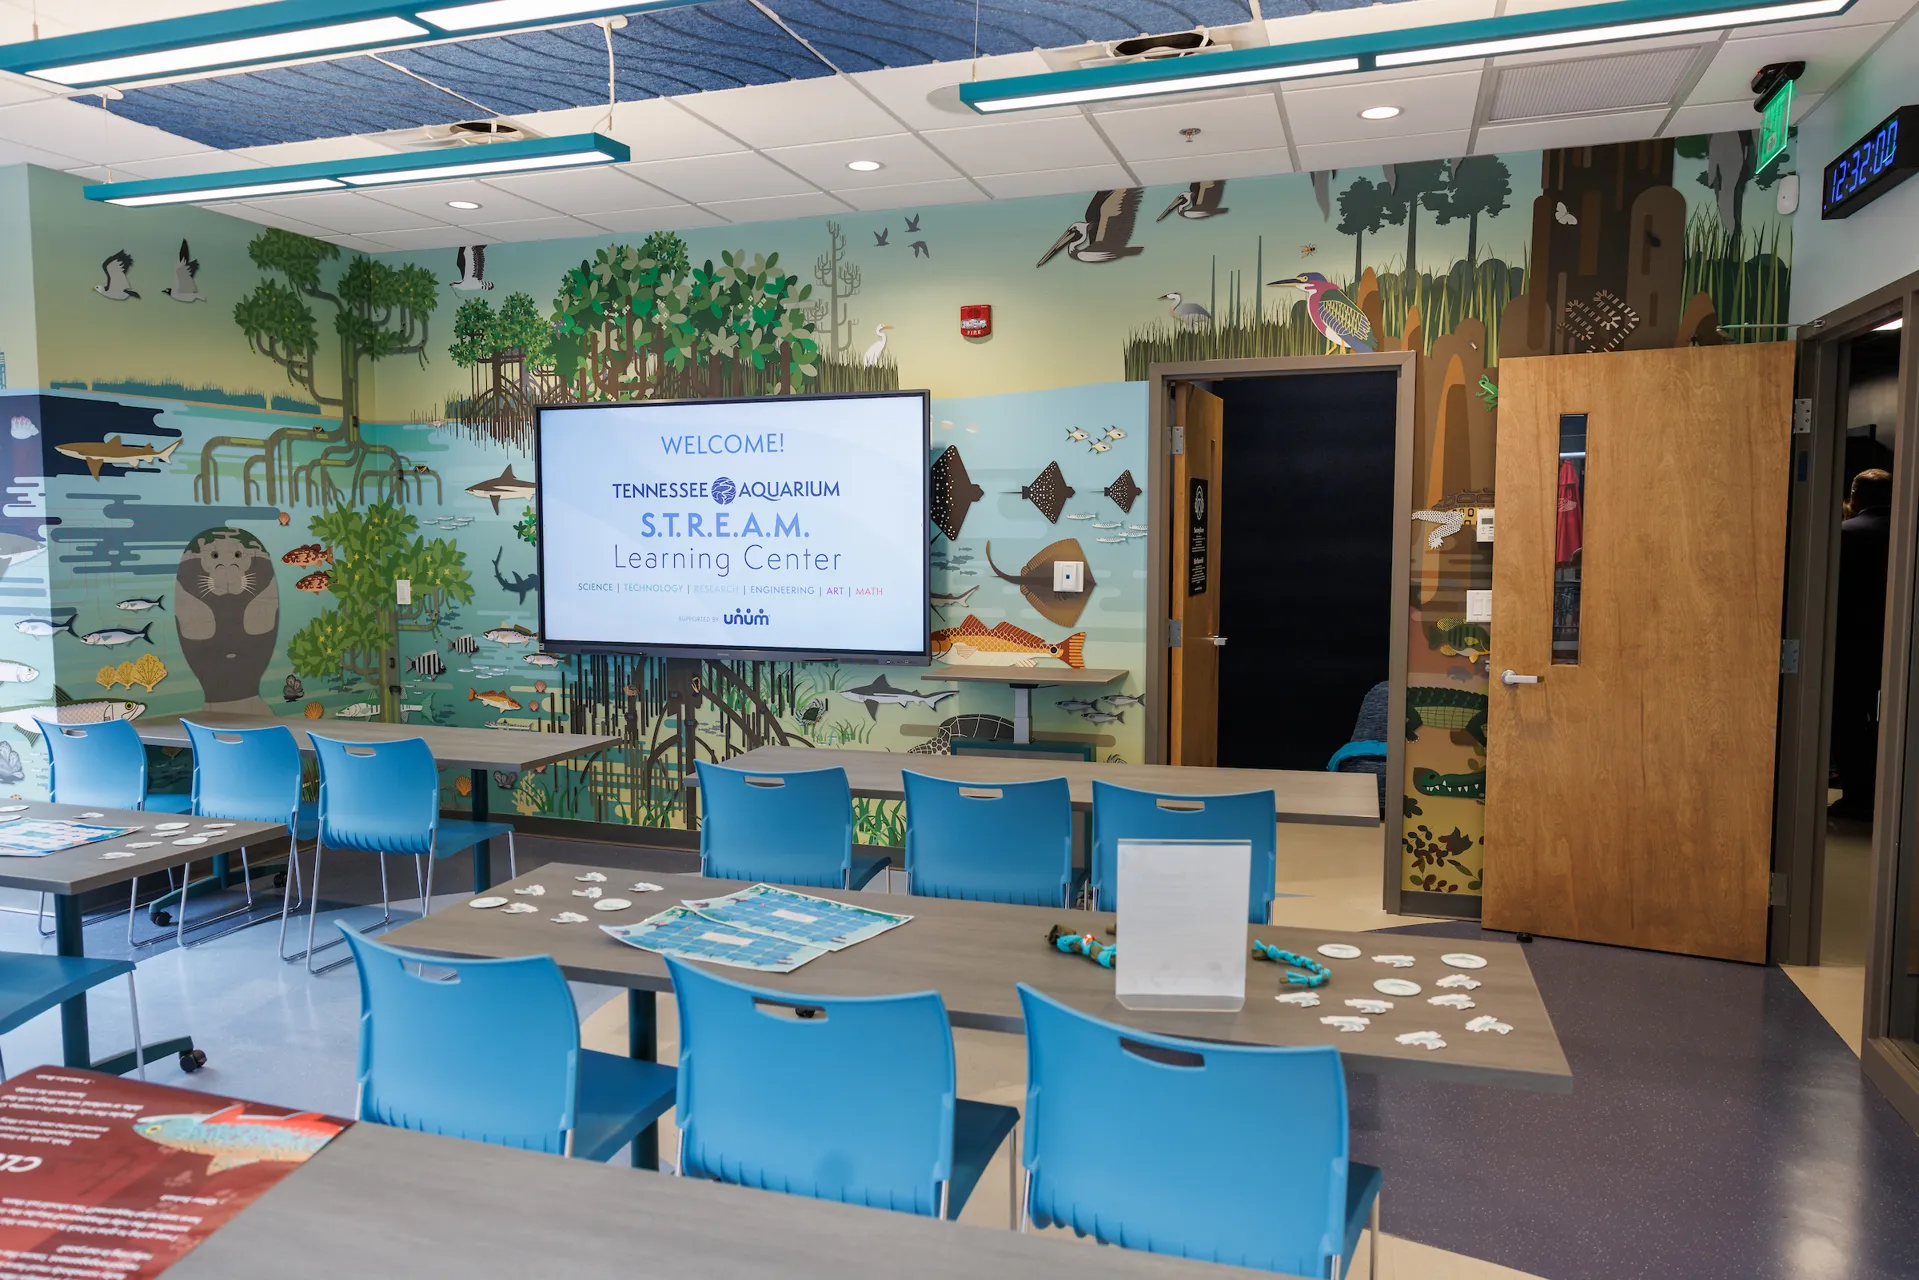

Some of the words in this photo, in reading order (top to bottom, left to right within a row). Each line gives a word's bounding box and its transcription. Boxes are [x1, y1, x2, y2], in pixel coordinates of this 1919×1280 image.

[1831, 119, 1899, 204] 12:32:00
[660, 433, 785, 455] WELCOME!
[612, 482, 709, 499] TENNESSEE
[738, 480, 841, 502] AQUARIUM
[640, 511, 810, 538] S.T.R.E.A.M.
[614, 543, 731, 578] Learning
[743, 543, 842, 571] Center
[577, 582, 614, 592] SCIENCE
[623, 583, 684, 593] TECHNOLOGY
[693, 584, 740, 594] RESEARCH
[750, 585, 815, 595] ENGINEERING
[826, 586, 845, 596] ART
[855, 587, 884, 596] MATH
